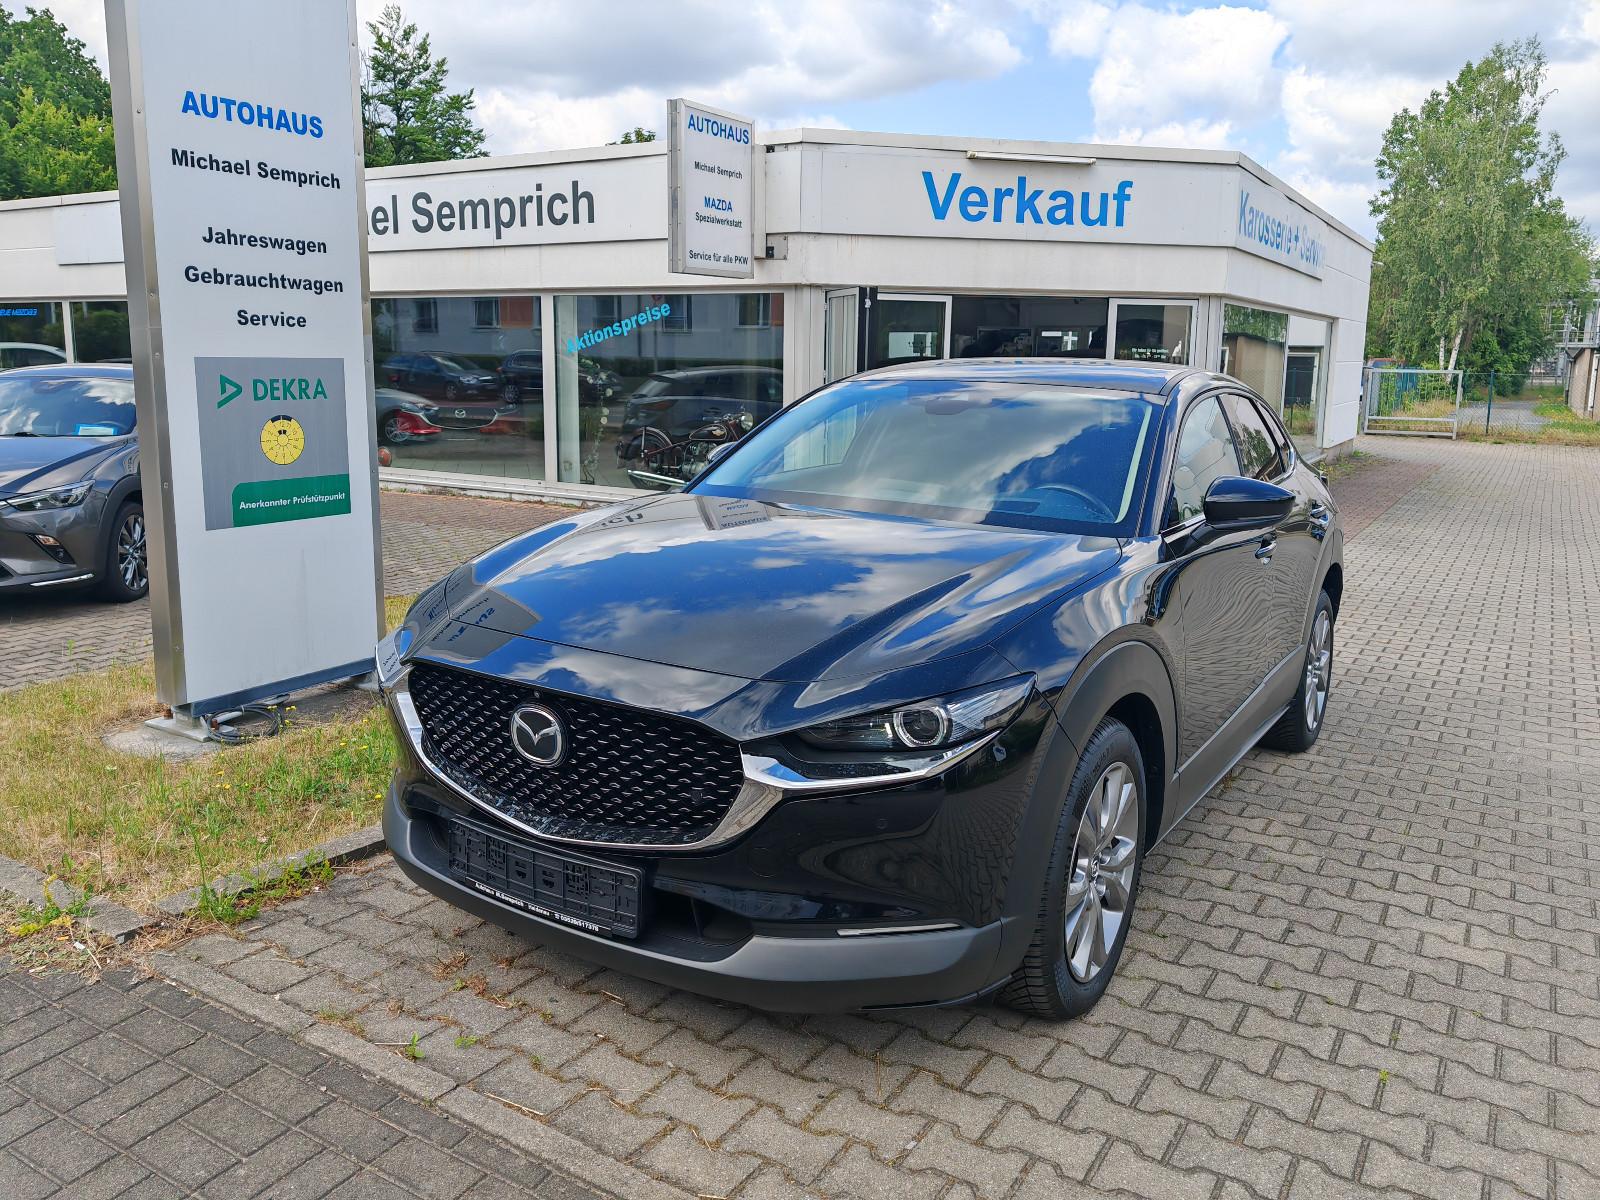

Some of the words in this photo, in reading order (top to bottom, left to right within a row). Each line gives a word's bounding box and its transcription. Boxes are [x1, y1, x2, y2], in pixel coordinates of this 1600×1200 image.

[181, 91, 323, 138] AUTOHAUS
[688, 114, 749, 145] AUTOHAUS
[171, 148, 250, 176] Michael
[257, 162, 341, 189] Semprich
[694, 161, 716, 174] Michael
[717, 166, 743, 179] Semprich
[411, 180, 595, 240] Semprich
[704, 196, 733, 212] MAZDA
[922, 171, 1134, 227] Verkauf
[695, 211, 743, 229] Spezialwerkstatt
[1239, 189, 1292, 255] Karosserie
[202, 227, 327, 255] Jahreswagen
[688, 250, 712, 262] Service
[713, 253, 722, 263] für
[723, 255, 734, 264] alle
[735, 256, 749, 265] PKW
[184, 266, 343, 295] Gebrauchtwagen
[237, 309, 307, 328] Service
[566, 303, 671, 354] Aktionspreise
[252, 378, 328, 401] DEKRA
[239, 499, 291, 510] Anerkannter
[292, 492, 346, 504] Prüfstützpunkt
